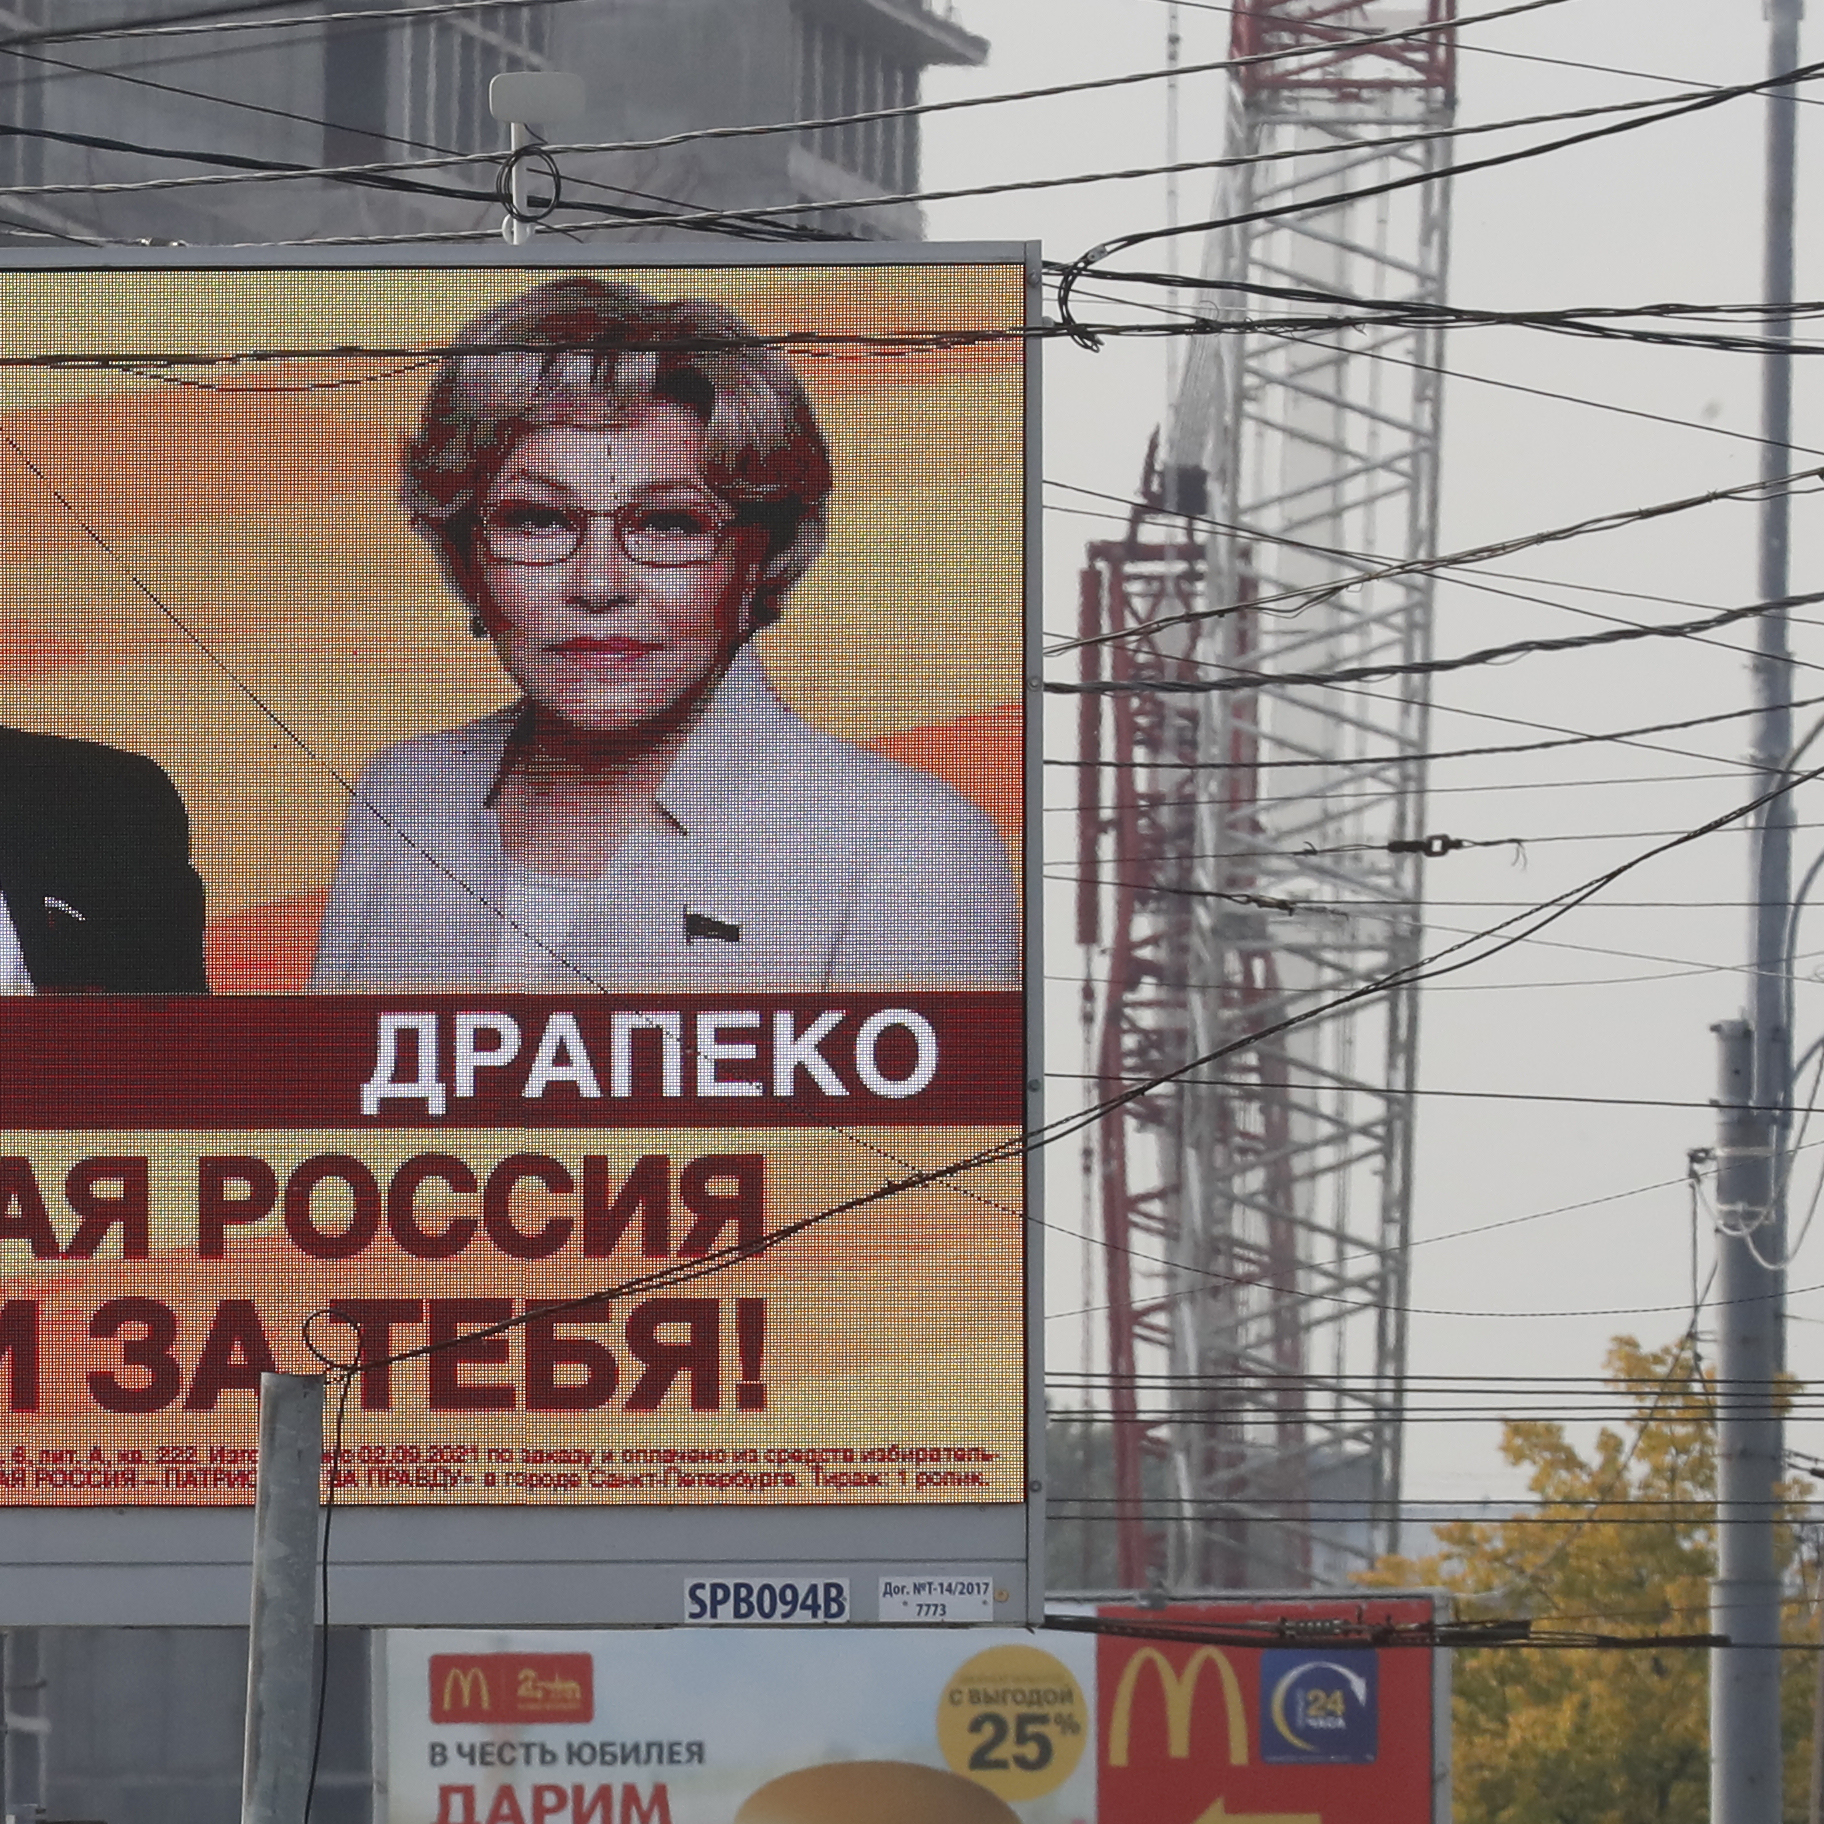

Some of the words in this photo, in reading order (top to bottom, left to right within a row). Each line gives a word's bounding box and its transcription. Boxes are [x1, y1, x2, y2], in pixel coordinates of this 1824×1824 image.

[359, 1009, 939, 1117] ДРАПЕКО
[198, 1153, 765, 1260] РОССИЯ
[87, 1296, 285, 1412] ЗА
[329, 1297, 765, 1411] ТЕБЯ!
[688, 1583, 846, 1620] SPB094B
[882, 1581, 910, 1598] Дог.
[916, 1602, 946, 1617] 7773
[968, 1684, 1075, 1708] ВЫГОДОЙ
[1306, 1689, 1346, 1718] 24
[429, 1742, 448, 1769] В
[456, 1741, 559, 1768] ЧЕСТЬ
[566, 1740, 706, 1768] ЮБИЛЕЯ
